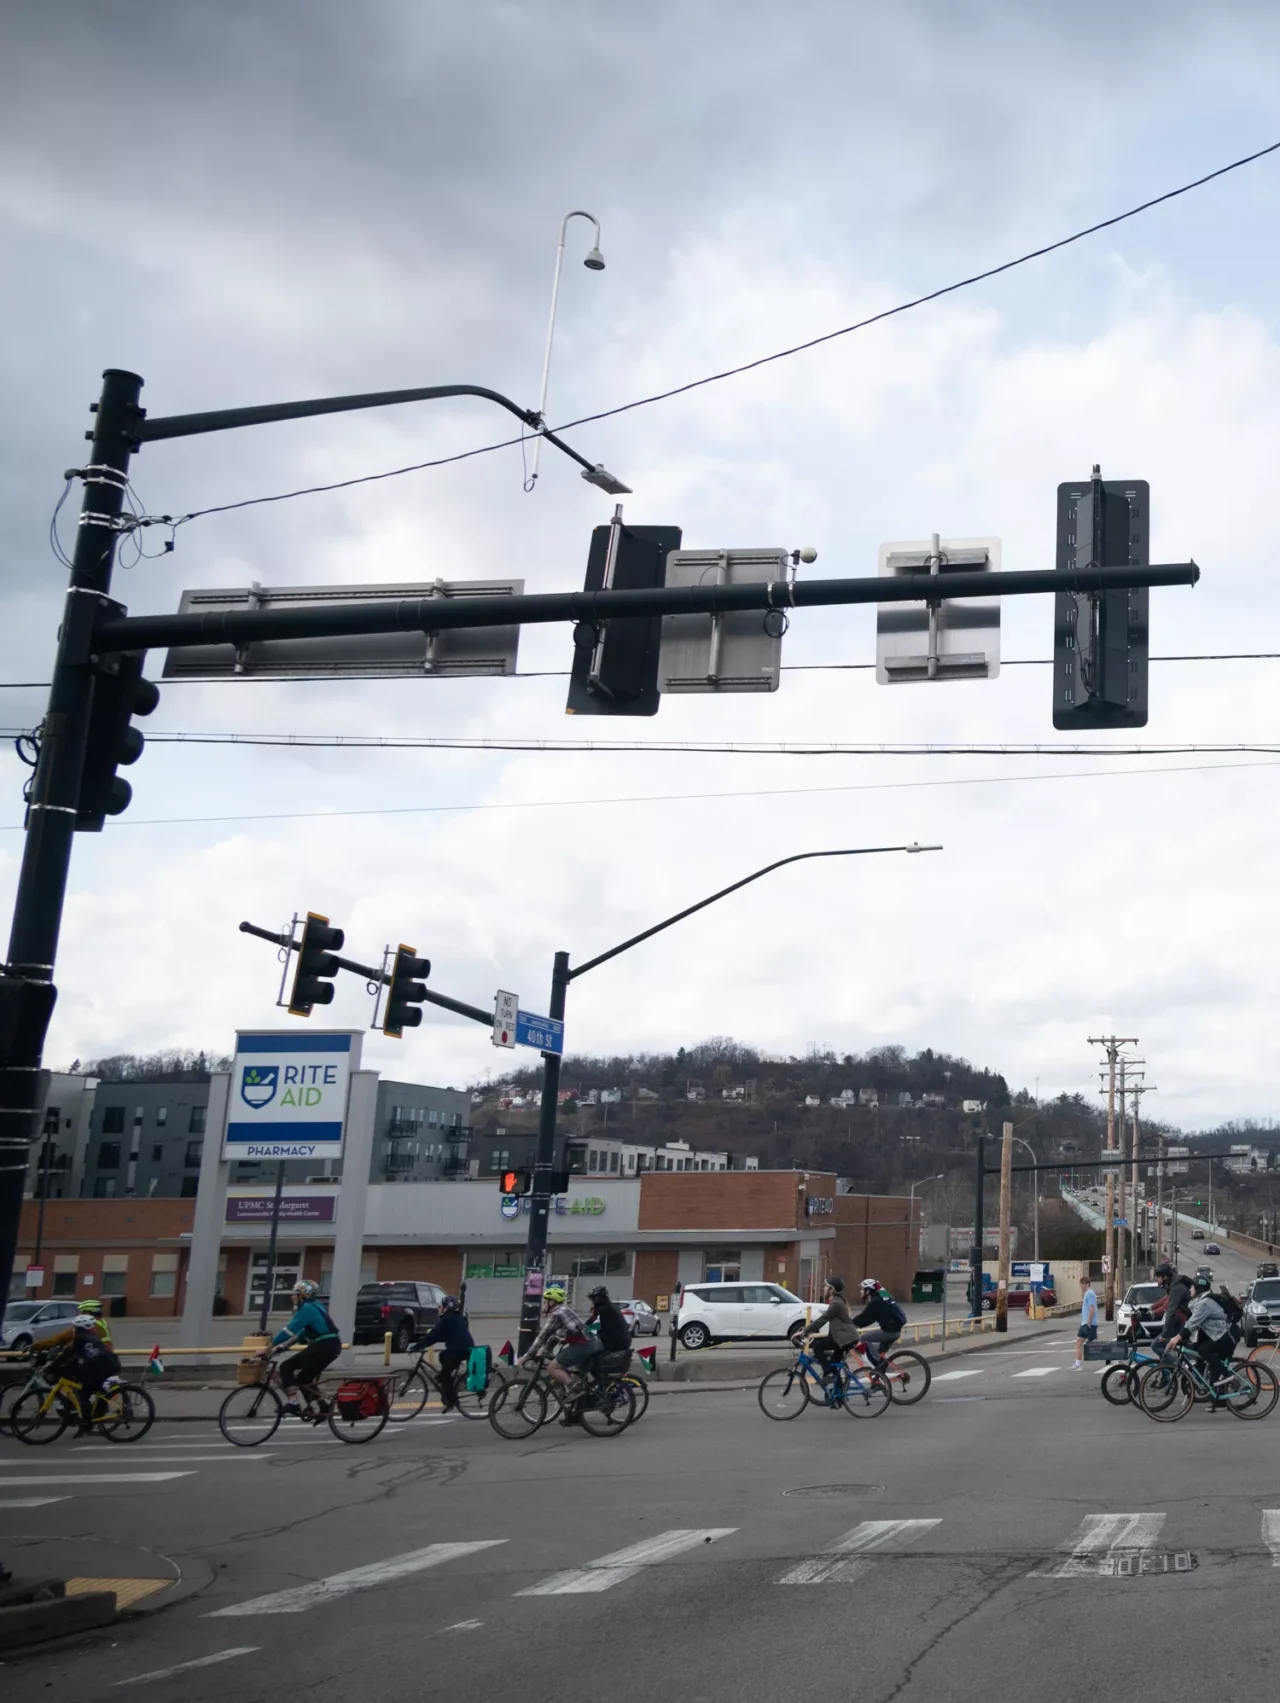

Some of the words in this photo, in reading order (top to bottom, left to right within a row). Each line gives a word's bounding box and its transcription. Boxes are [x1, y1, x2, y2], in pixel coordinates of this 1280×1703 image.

[503, 996, 512, 1007] NO
[500, 1008, 513, 1019] TURN
[495, 1020, 502, 1029] ON
[505, 1021, 515, 1032] RED
[527, 1029, 543, 1045] 40th
[545, 1034, 552, 1048] St
[284, 1065, 338, 1085] RITE
[280, 1087, 322, 1107] AID
[247, 1145, 317, 1156] PHARMACY
[238, 1201, 265, 1209] UPMC
[523, 1198, 566, 1215] RE
[571, 1197, 605, 1215] AID
